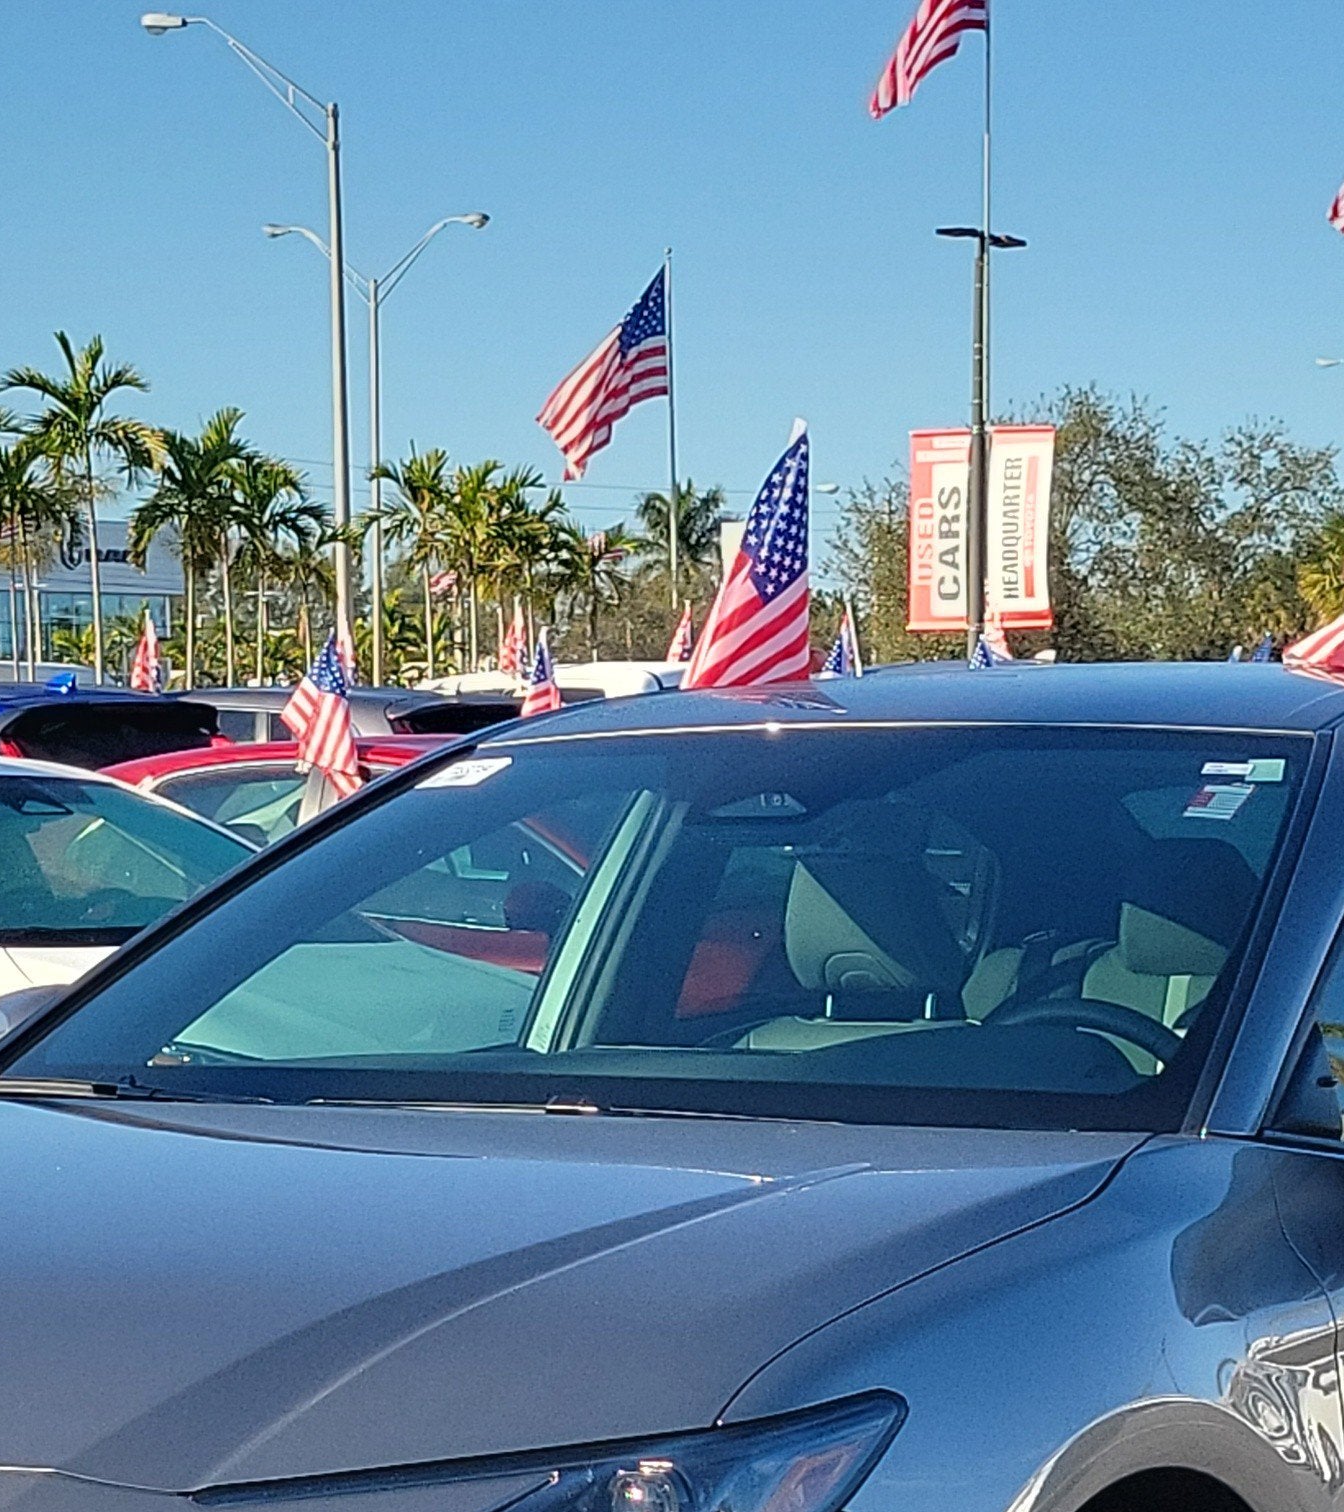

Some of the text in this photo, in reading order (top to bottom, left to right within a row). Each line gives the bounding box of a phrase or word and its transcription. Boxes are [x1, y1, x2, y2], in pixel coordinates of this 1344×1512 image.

[918, 502, 934, 580] USED
[938, 486, 961, 601] CARS
[1002, 457, 1022, 599] HEADQUARTER
